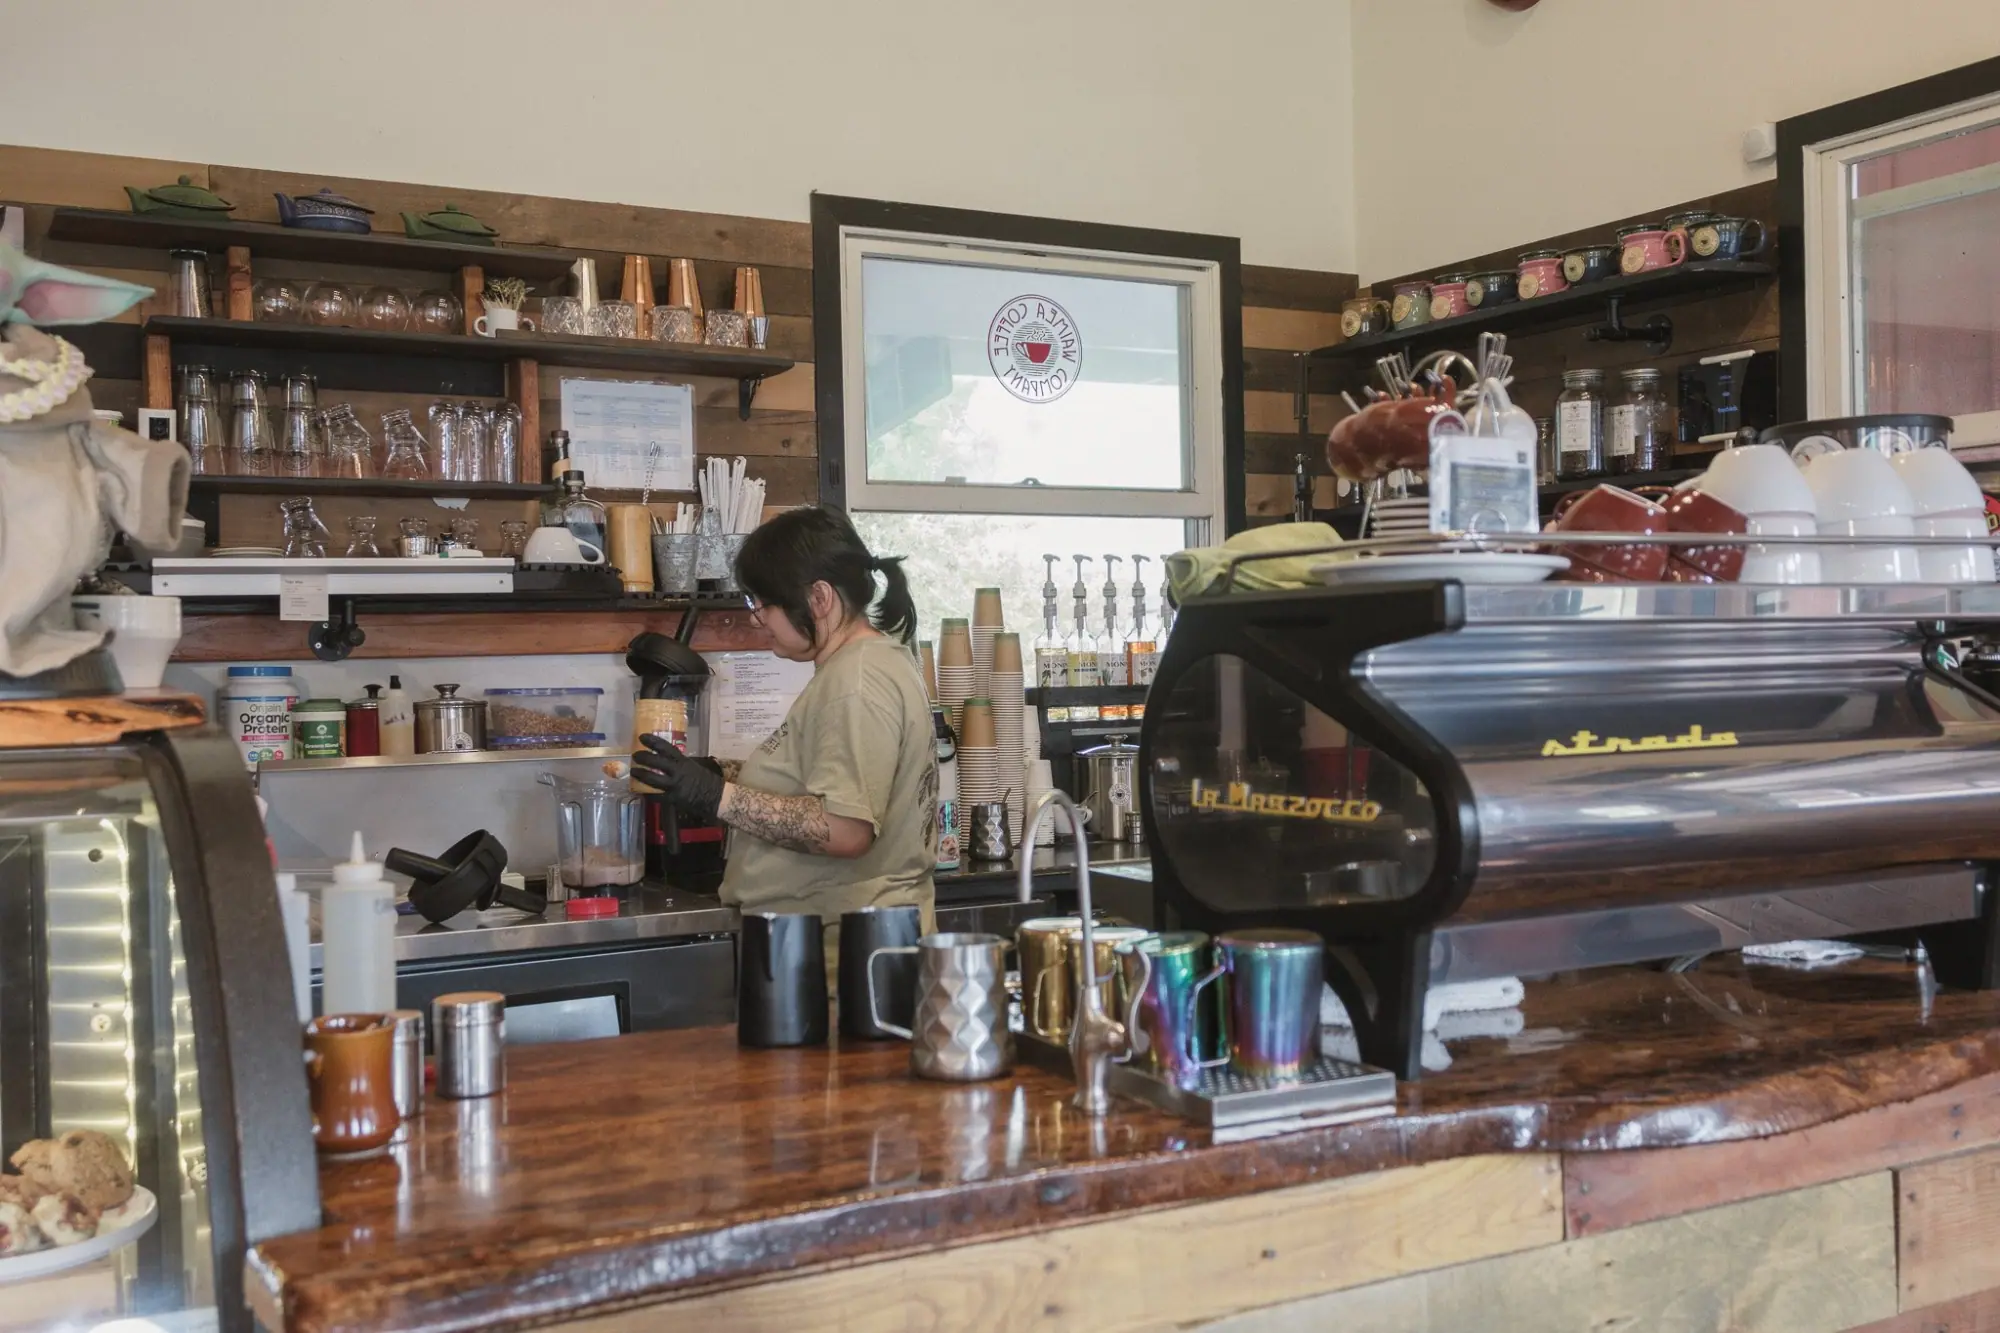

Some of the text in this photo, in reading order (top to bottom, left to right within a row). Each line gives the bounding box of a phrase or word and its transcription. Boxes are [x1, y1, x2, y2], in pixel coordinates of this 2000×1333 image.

[239, 713, 290, 724] Organic
[244, 724, 287, 734] Protein
[1541, 724, 1739, 757] strada
